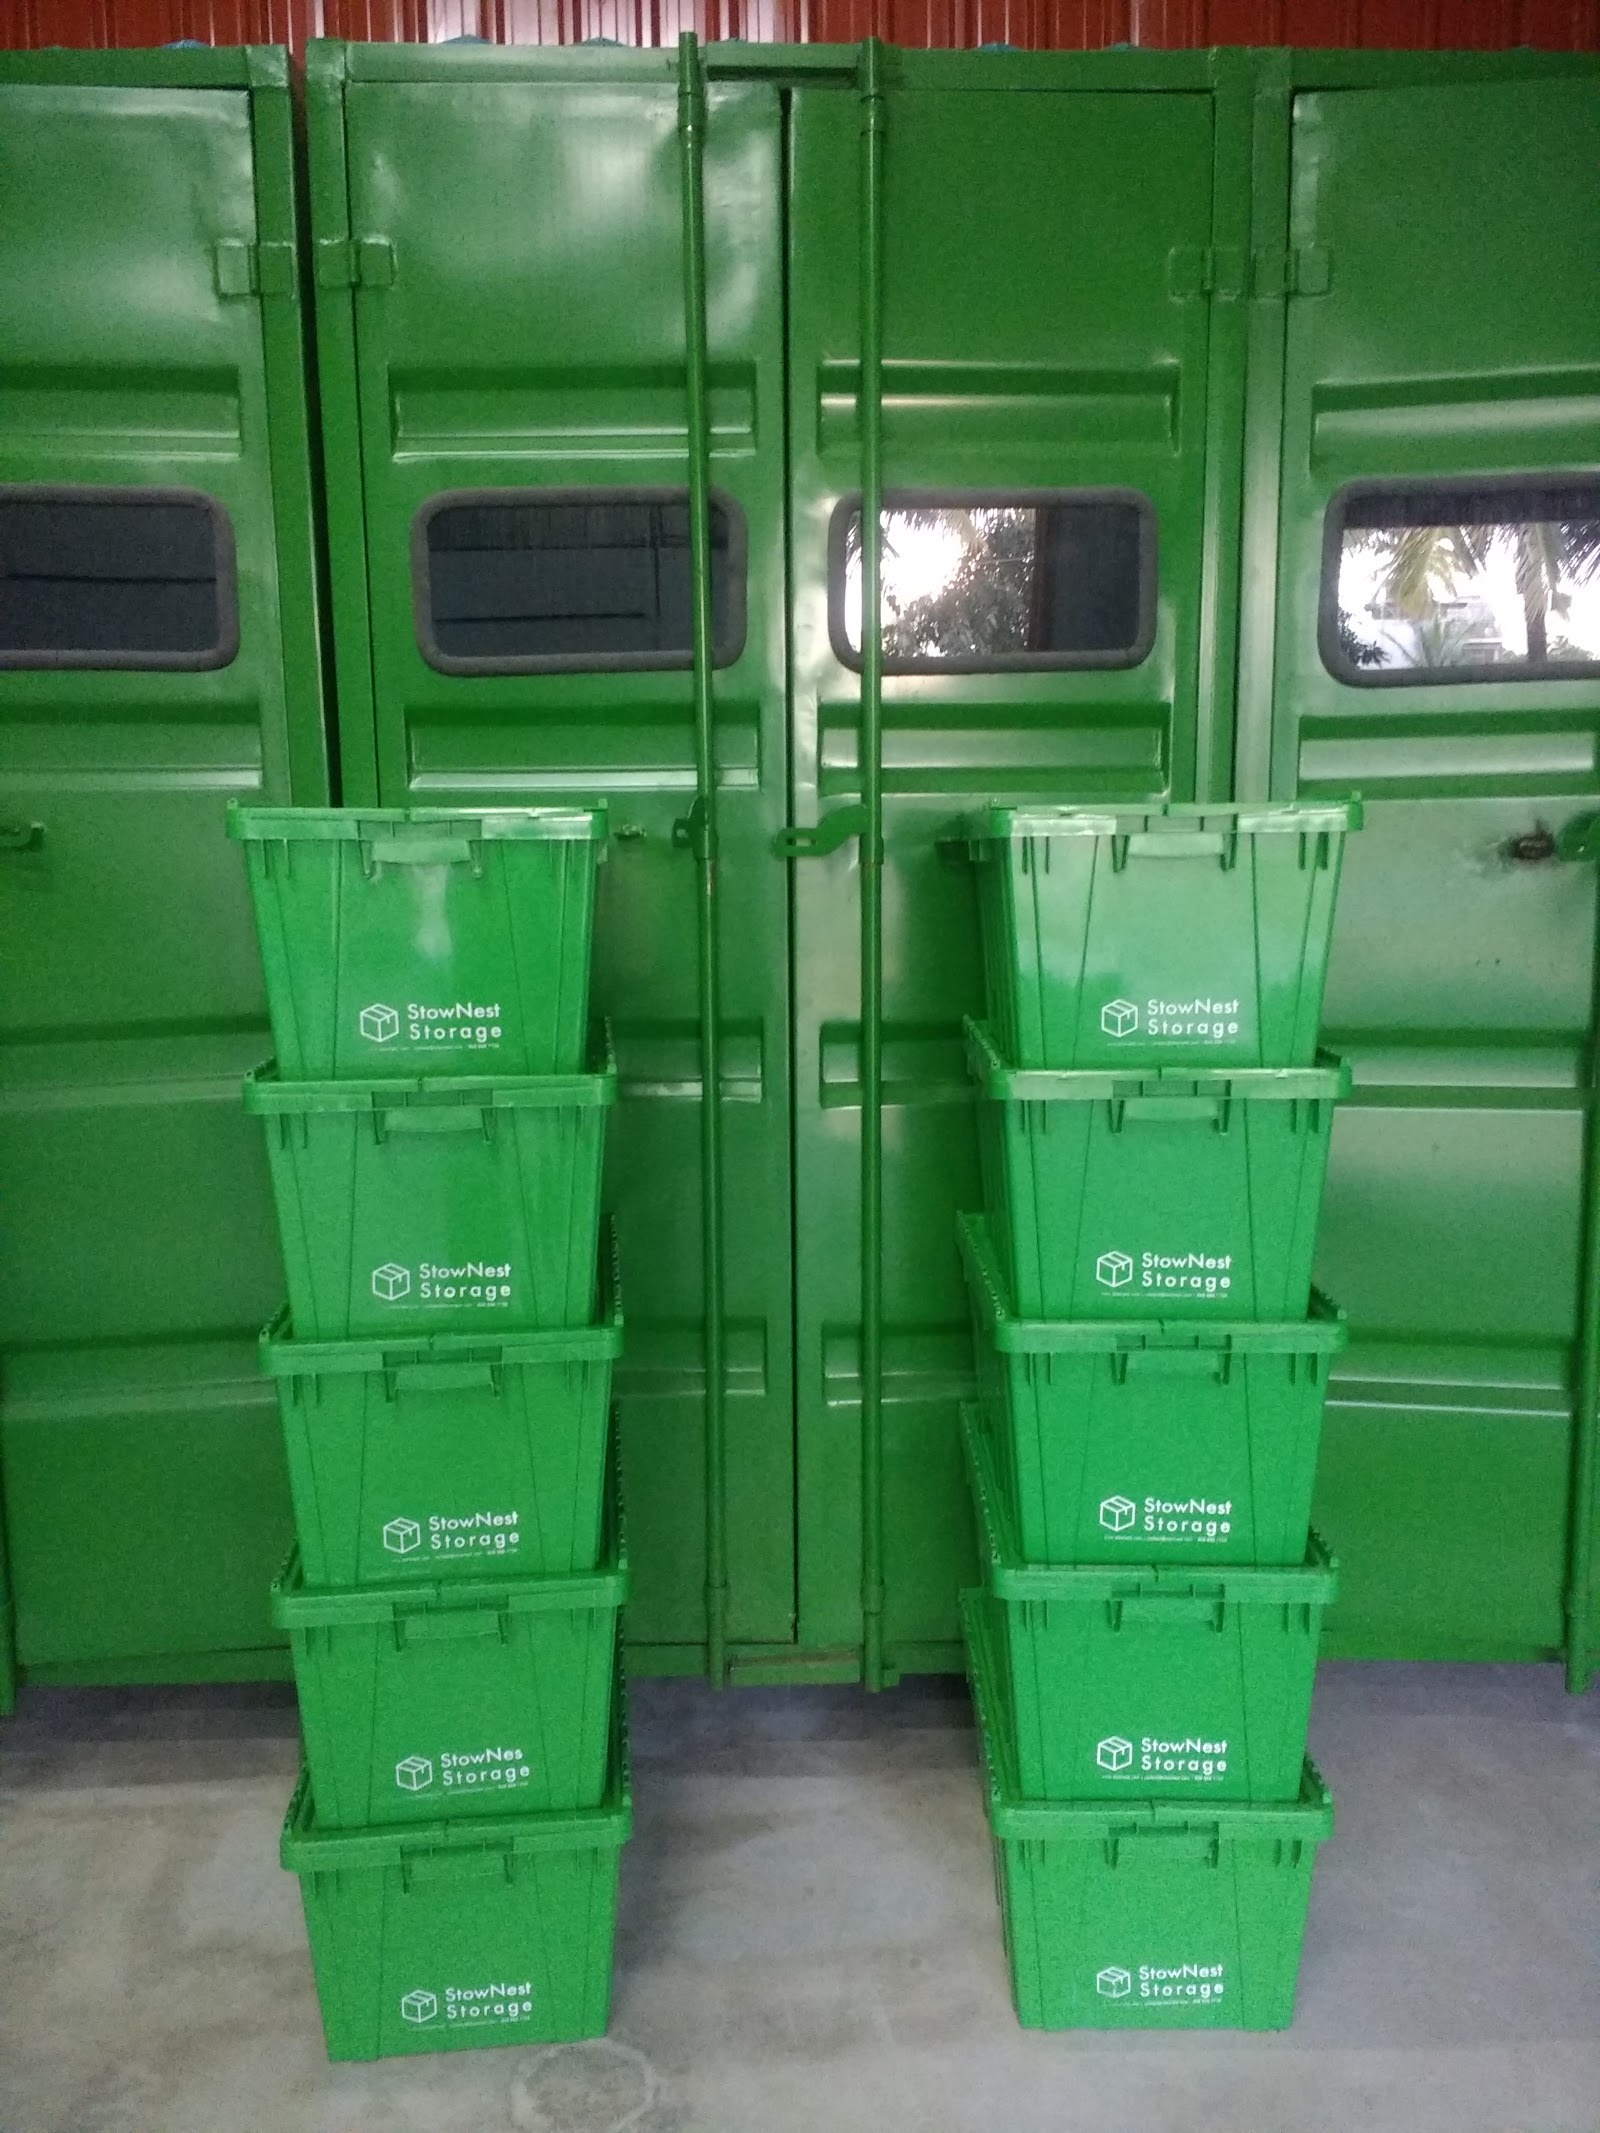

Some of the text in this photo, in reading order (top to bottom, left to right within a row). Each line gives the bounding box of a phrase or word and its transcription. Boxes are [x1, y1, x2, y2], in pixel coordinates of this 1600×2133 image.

[408, 1001, 501, 1020] StowNest
[1147, 998, 1239, 1016] StowNest
[410, 1022, 502, 1043] Storage
[1147, 1018, 1239, 1039] Storage
[419, 1261, 512, 1280] StowNest
[1141, 1251, 1233, 1270] StowNest
[1141, 1269, 1232, 1292] Storage
[420, 1283, 512, 1302] Storage
[1143, 1495, 1233, 1514] StowNest
[428, 1510, 519, 1532] StowNest
[1143, 1514, 1232, 1536] Storage
[430, 1531, 520, 1550] Storage
[1140, 1735, 1228, 1755] StowNest
[1141, 1754, 1228, 1776] Storage
[442, 1765, 530, 1787] Storage
[1138, 1962, 1224, 1981] StowNest
[445, 1981, 532, 2003] StowNest
[1140, 1981, 1224, 2000] Storage
[446, 2000, 533, 2020] Storage
